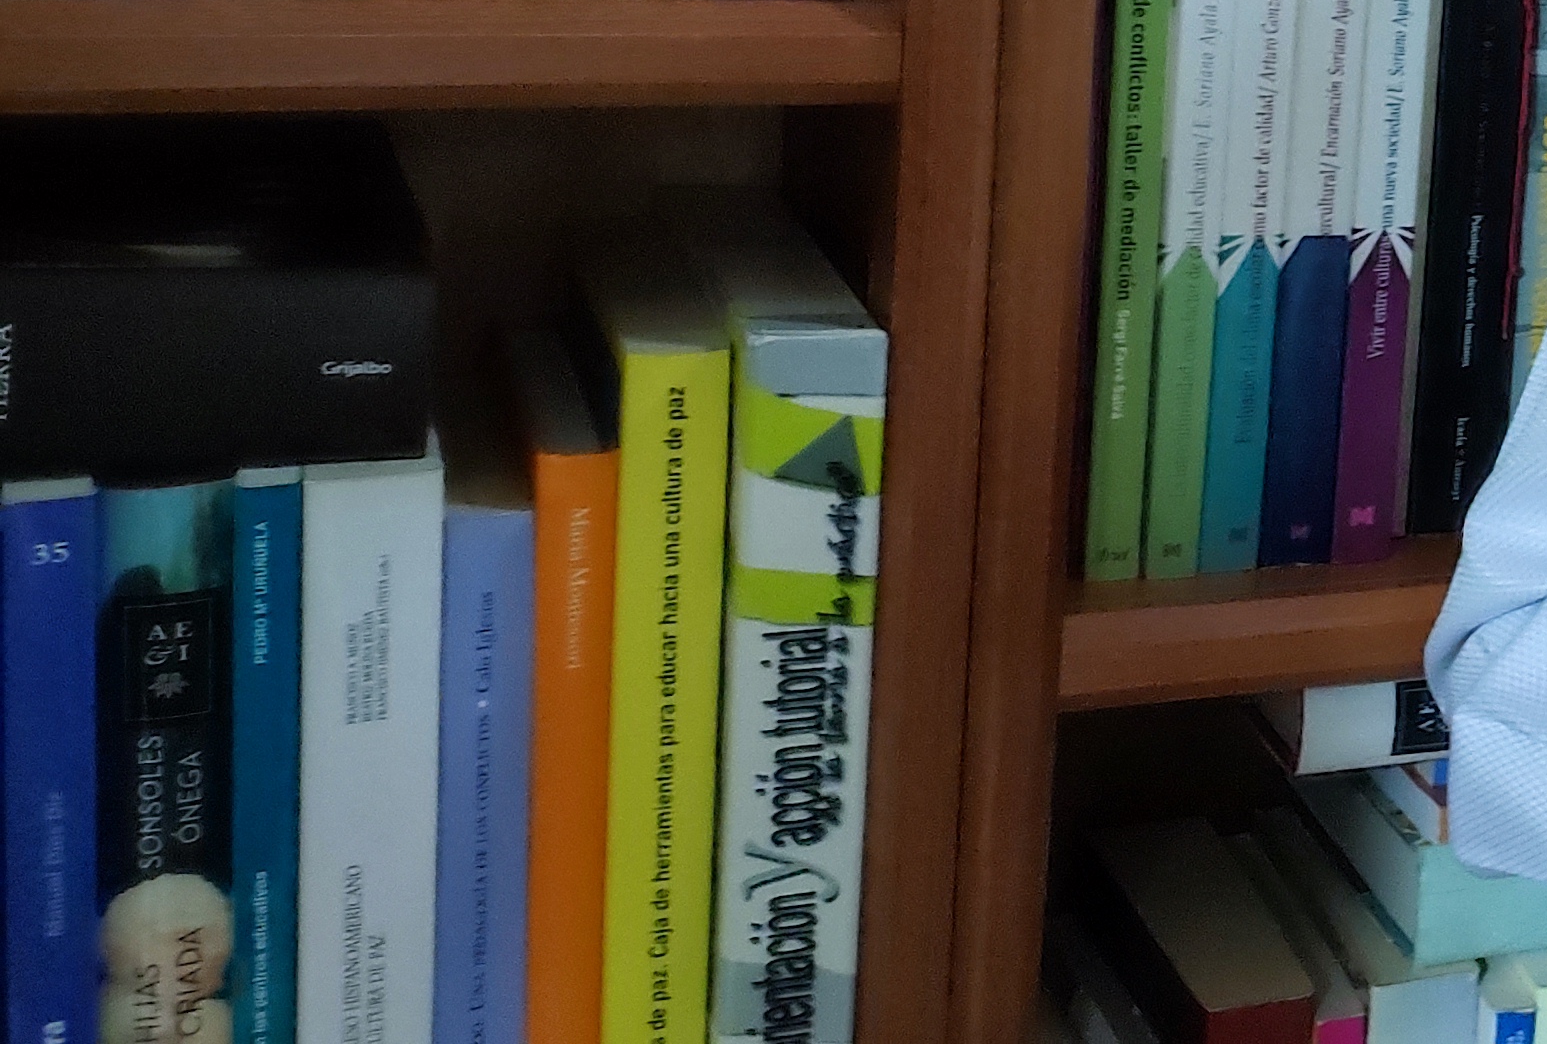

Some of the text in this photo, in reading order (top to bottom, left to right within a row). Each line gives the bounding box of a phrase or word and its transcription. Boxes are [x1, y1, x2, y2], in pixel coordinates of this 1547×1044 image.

[1125, 23, 1150, 119] conflictos:
[1387, 29, 1408, 76] Soriano
[1123, 124, 1145, 174] taller
[1380, 94, 1406, 157] sociedad/
[1122, 179, 1142, 202] de
[1378, 204, 1394, 227] una
[1380, 161, 1398, 199] nueva
[1115, 207, 1141, 301] mediación
[1368, 289, 1388, 322] entre
[319, 360, 394, 379] Grijalbo
[1364, 325, 1385, 359] Vivir
[31, 541, 70, 567] 35
[644, 386, 689, 1029] de paz. Caja de herramientas para educar hacia una cultura de paz
[756, 625, 828, 740] tutorial
[138, 735, 163, 868] SONSOLES
[172, 750, 203, 842] ÓNEGA
[754, 742, 825, 847] acción
[175, 925, 203, 1035] CRIADA
[745, 889, 818, 1044] rientación
[133, 963, 163, 1043] HIJAS
